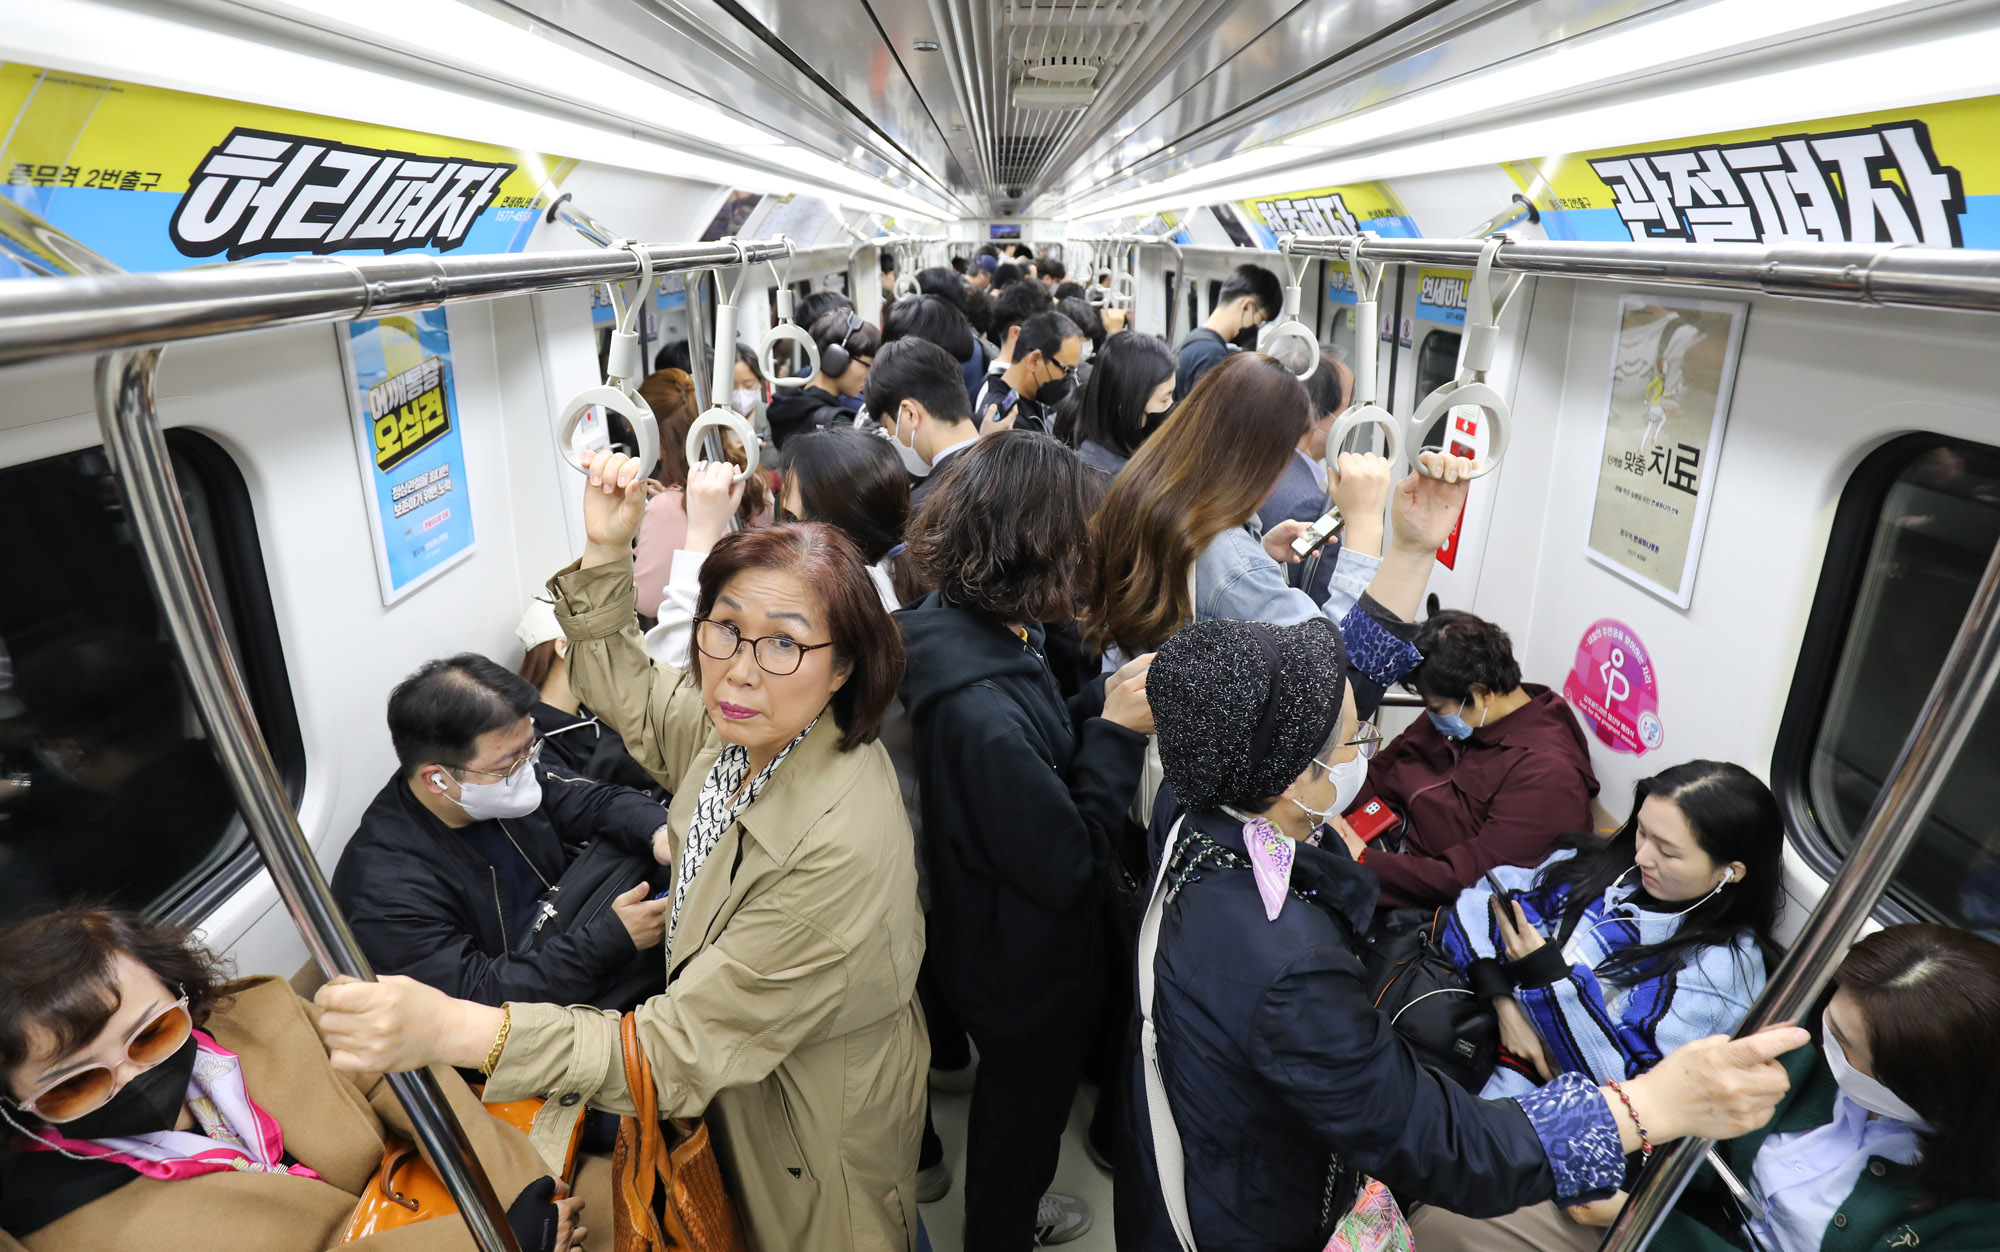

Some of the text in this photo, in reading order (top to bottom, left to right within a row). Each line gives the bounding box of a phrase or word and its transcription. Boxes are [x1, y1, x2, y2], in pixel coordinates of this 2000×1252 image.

[84, 169, 162, 192] 2번출구
[172, 130, 513, 254] 허리펴자
[369, 357, 440, 421] 어깨통증
[375, 386, 446, 466] 오십견
[1607, 443, 1700, 496] 단계별 맞춤 치료
[1642, 665, 1652, 684] 자리
